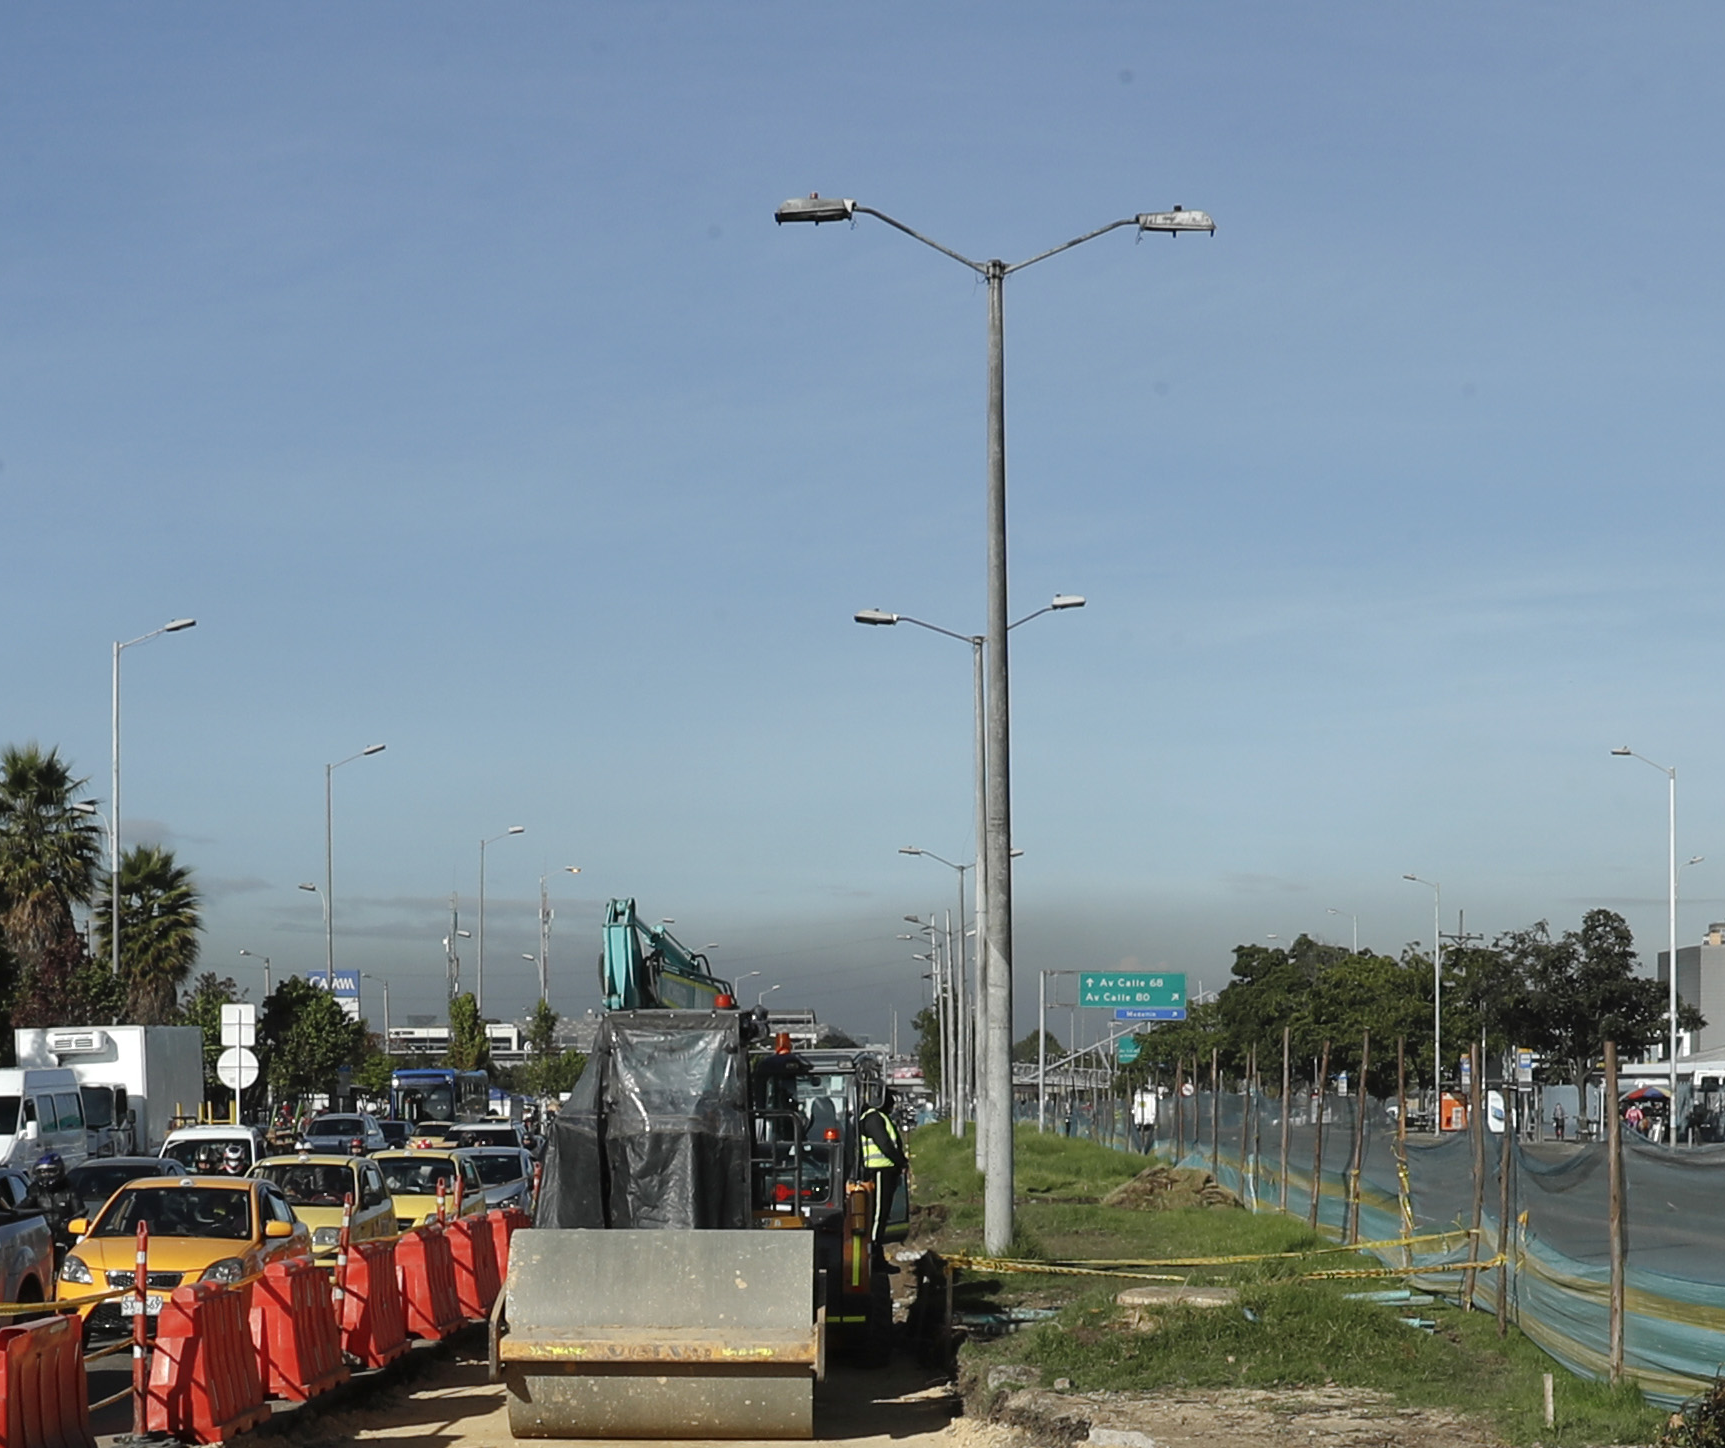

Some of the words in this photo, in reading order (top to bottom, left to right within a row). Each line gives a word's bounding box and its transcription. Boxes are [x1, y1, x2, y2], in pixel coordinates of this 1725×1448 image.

[1100, 978, 1114, 987] Av
[1117, 978, 1145, 987] Calle
[1085, 993, 1099, 1001] Av
[1103, 992, 1131, 1002] Calle
